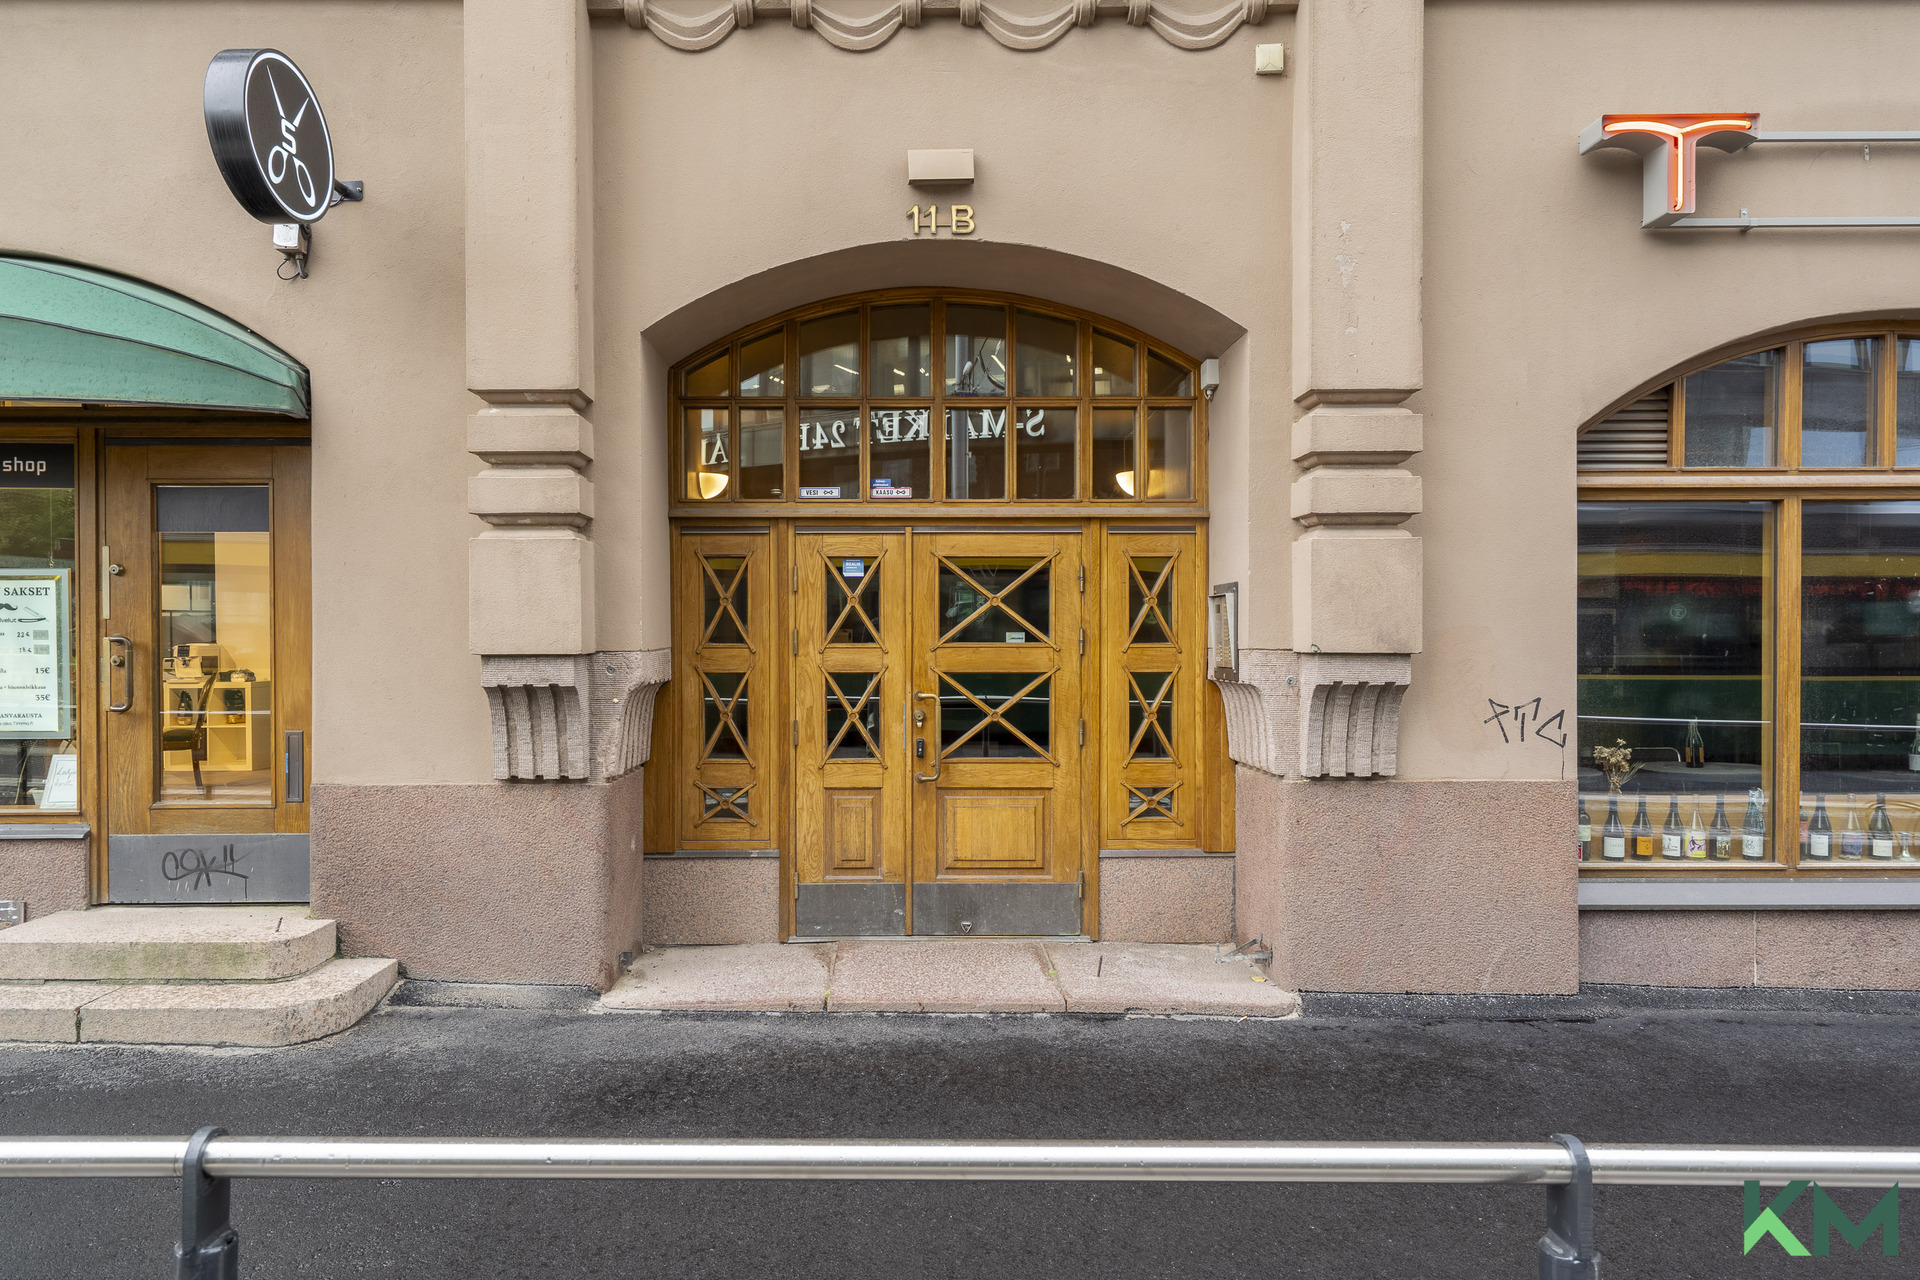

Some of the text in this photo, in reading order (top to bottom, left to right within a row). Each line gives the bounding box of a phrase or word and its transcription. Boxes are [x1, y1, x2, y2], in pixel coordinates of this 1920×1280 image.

[906, 204, 975, 235] 11 B
[2, 456, 47, 476] shop
[875, 487, 894, 495] KAASU
[3, 587, 50, 596] SAKSET
